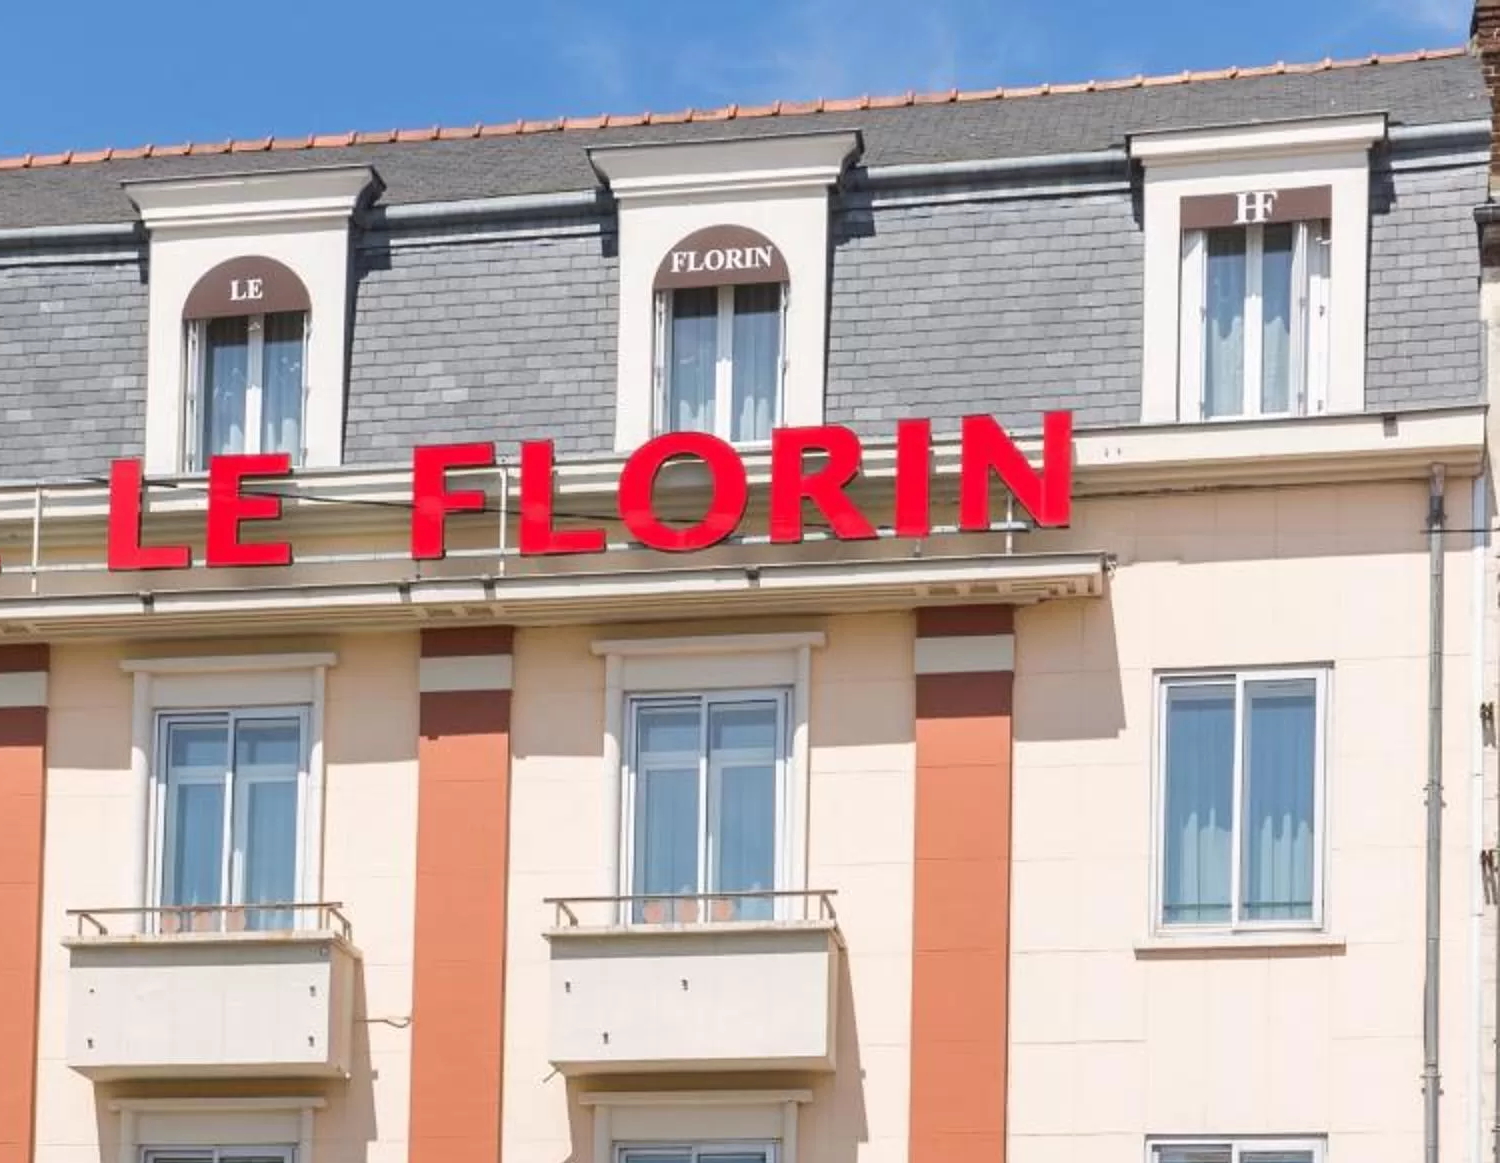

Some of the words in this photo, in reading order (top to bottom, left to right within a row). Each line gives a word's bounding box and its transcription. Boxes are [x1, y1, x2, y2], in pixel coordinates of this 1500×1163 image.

[670, 245, 773, 274] FLORIN
[230, 277, 263, 302] LE
[107, 453, 293, 572] LE
[411, 410, 1073, 560] FLORIN
